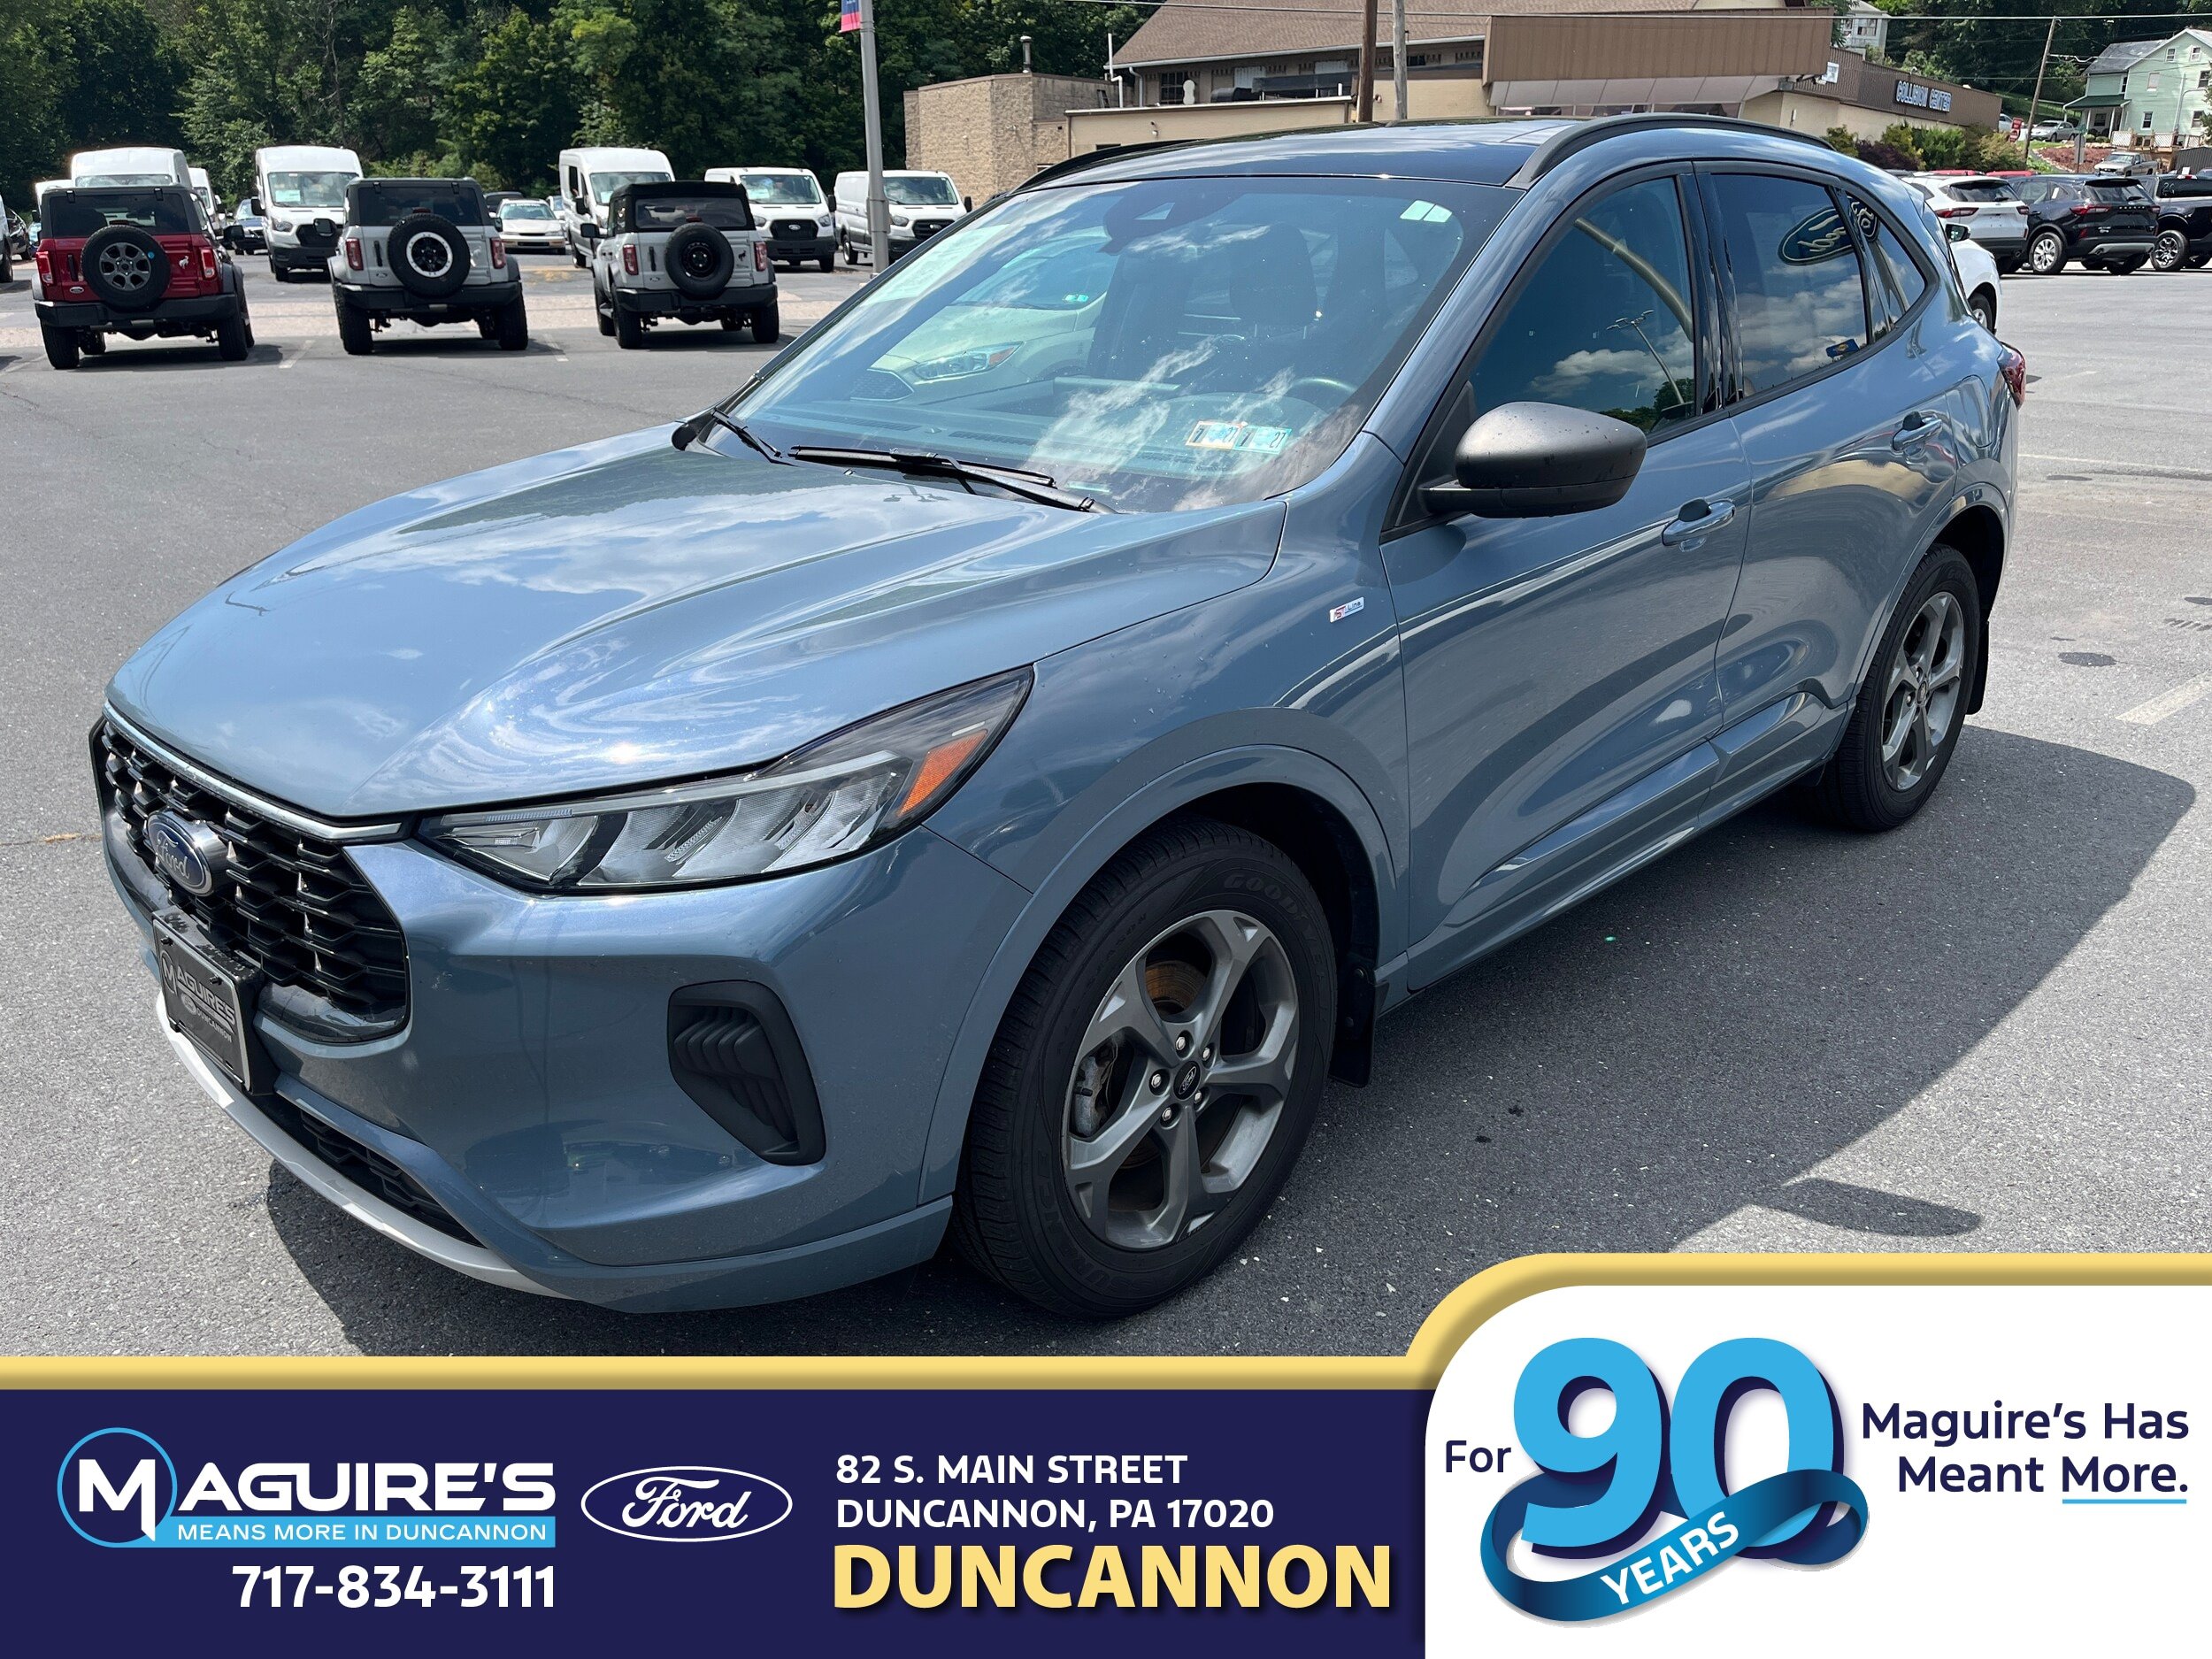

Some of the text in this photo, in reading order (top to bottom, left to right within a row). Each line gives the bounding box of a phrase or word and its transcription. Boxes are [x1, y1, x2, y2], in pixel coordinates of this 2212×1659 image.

[1896, 81, 1952, 111] COLLISION CENTER
[1269, 432, 1287, 449] 27
[156, 830, 189, 879] Ford
[1222, 869, 1326, 1021] GOODYEAR
